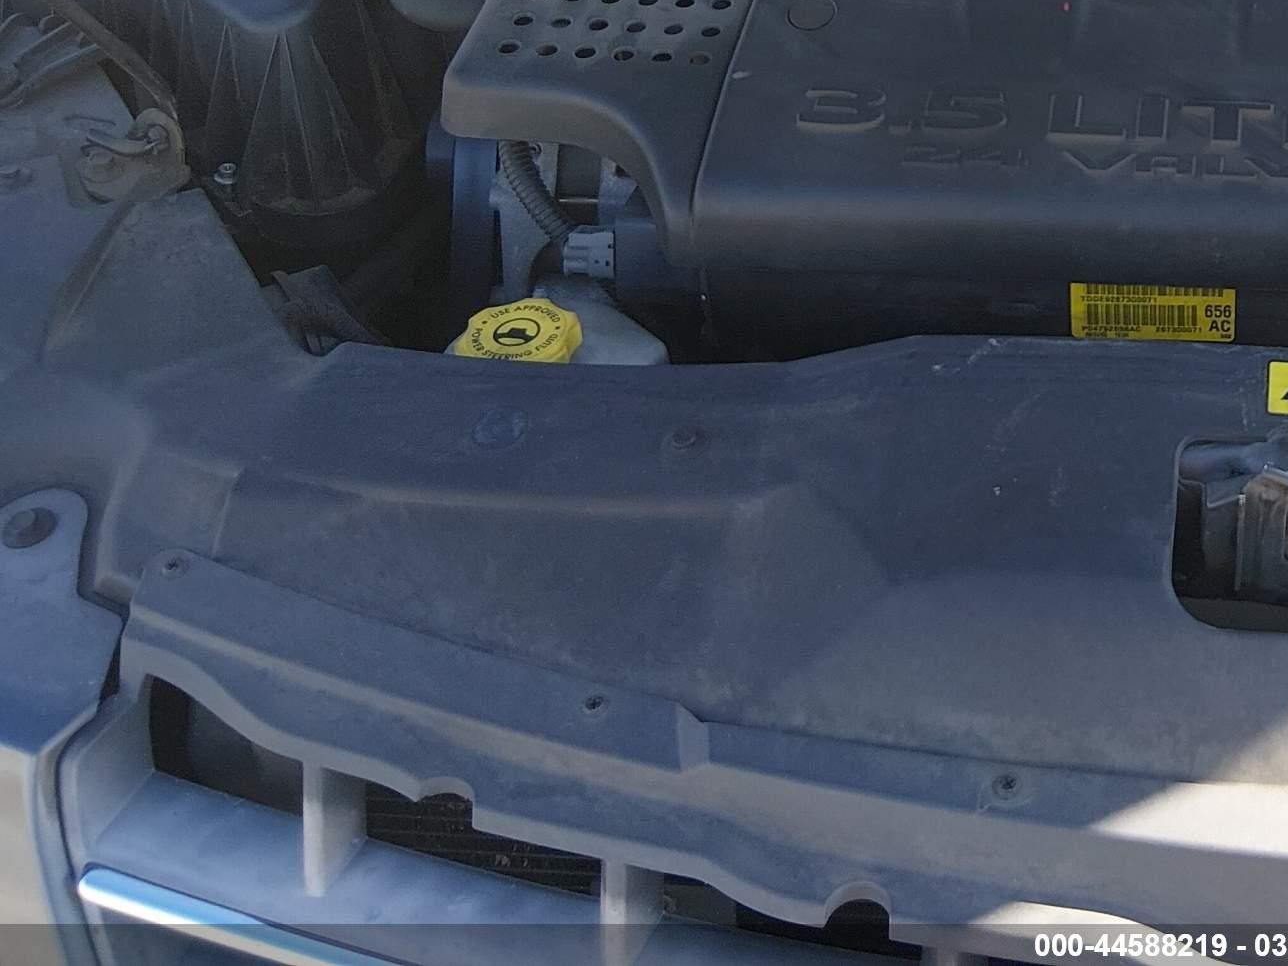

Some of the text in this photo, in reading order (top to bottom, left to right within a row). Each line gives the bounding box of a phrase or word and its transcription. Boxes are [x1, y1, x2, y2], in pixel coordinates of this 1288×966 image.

[796, 87, 1008, 134] 3.5
[490, 305, 561, 323] USE APPROVED
[1205, 305, 1232, 318] 656
[1208, 320, 1231, 332] AC
[471, 327, 486, 352] POWER
[535, 333, 559, 352] FLUID
